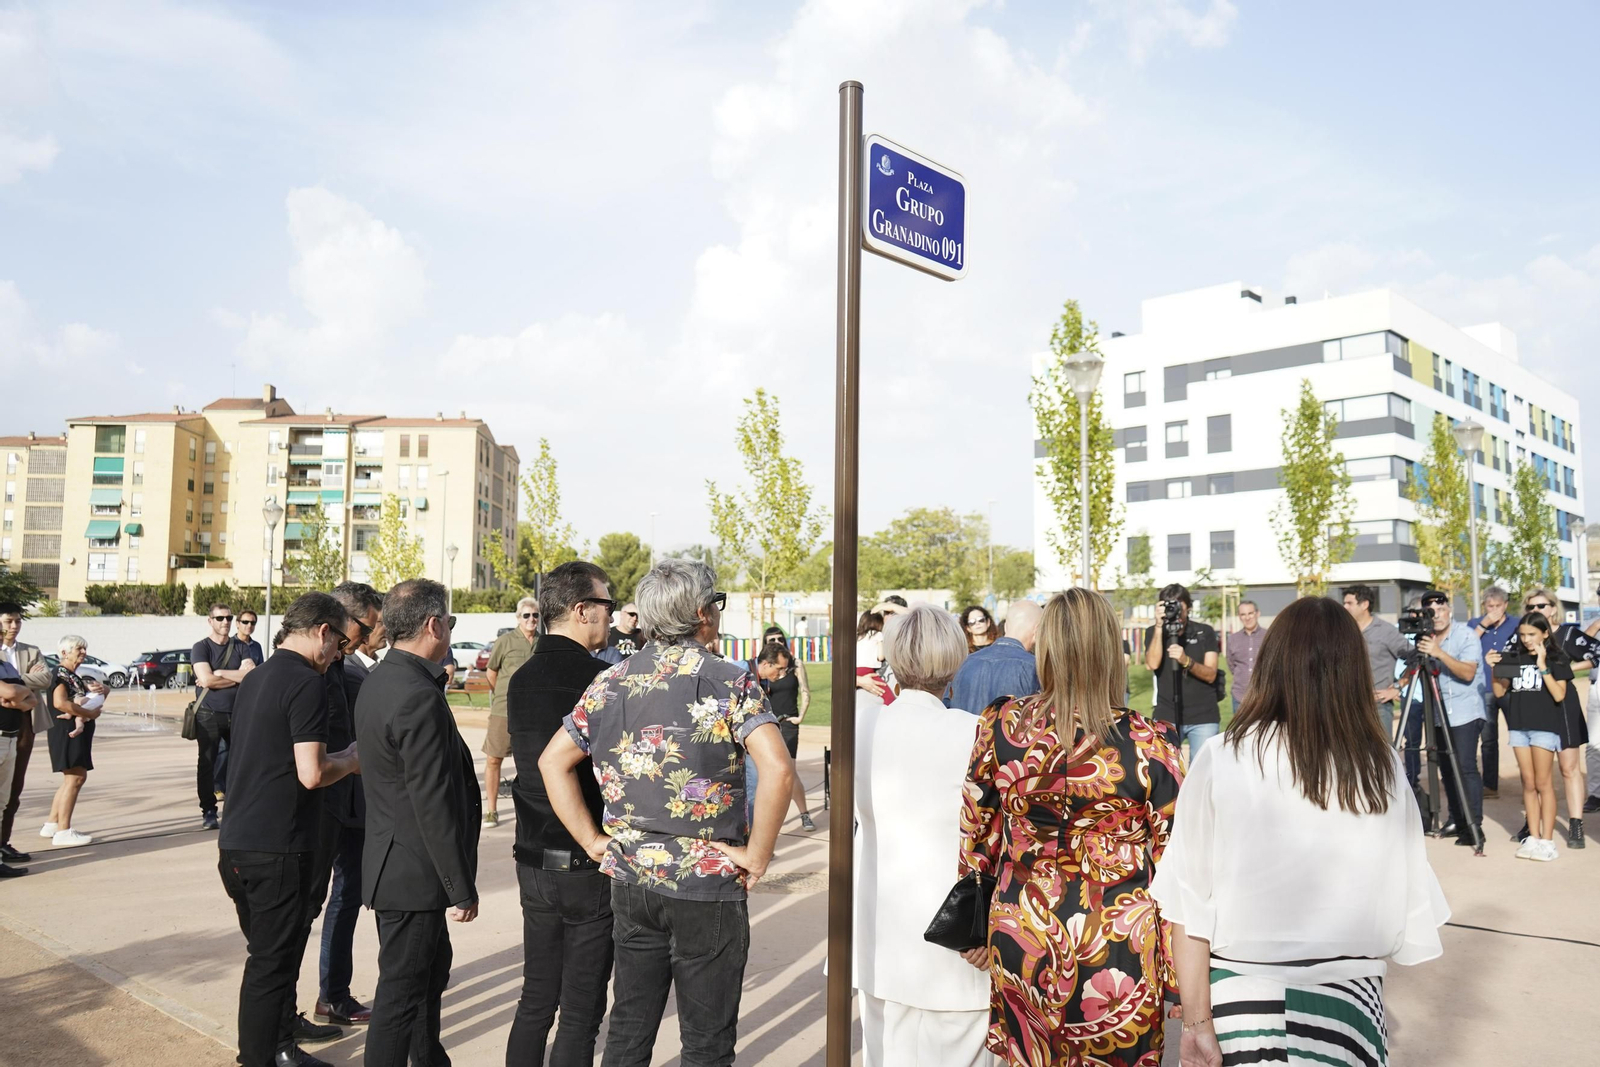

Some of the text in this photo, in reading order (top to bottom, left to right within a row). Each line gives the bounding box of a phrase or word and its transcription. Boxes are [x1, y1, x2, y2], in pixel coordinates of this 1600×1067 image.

[907, 171, 934, 195] PLAZA
[896, 186, 945, 226] GRUPO
[872, 208, 963, 266] GRANADINO 091
